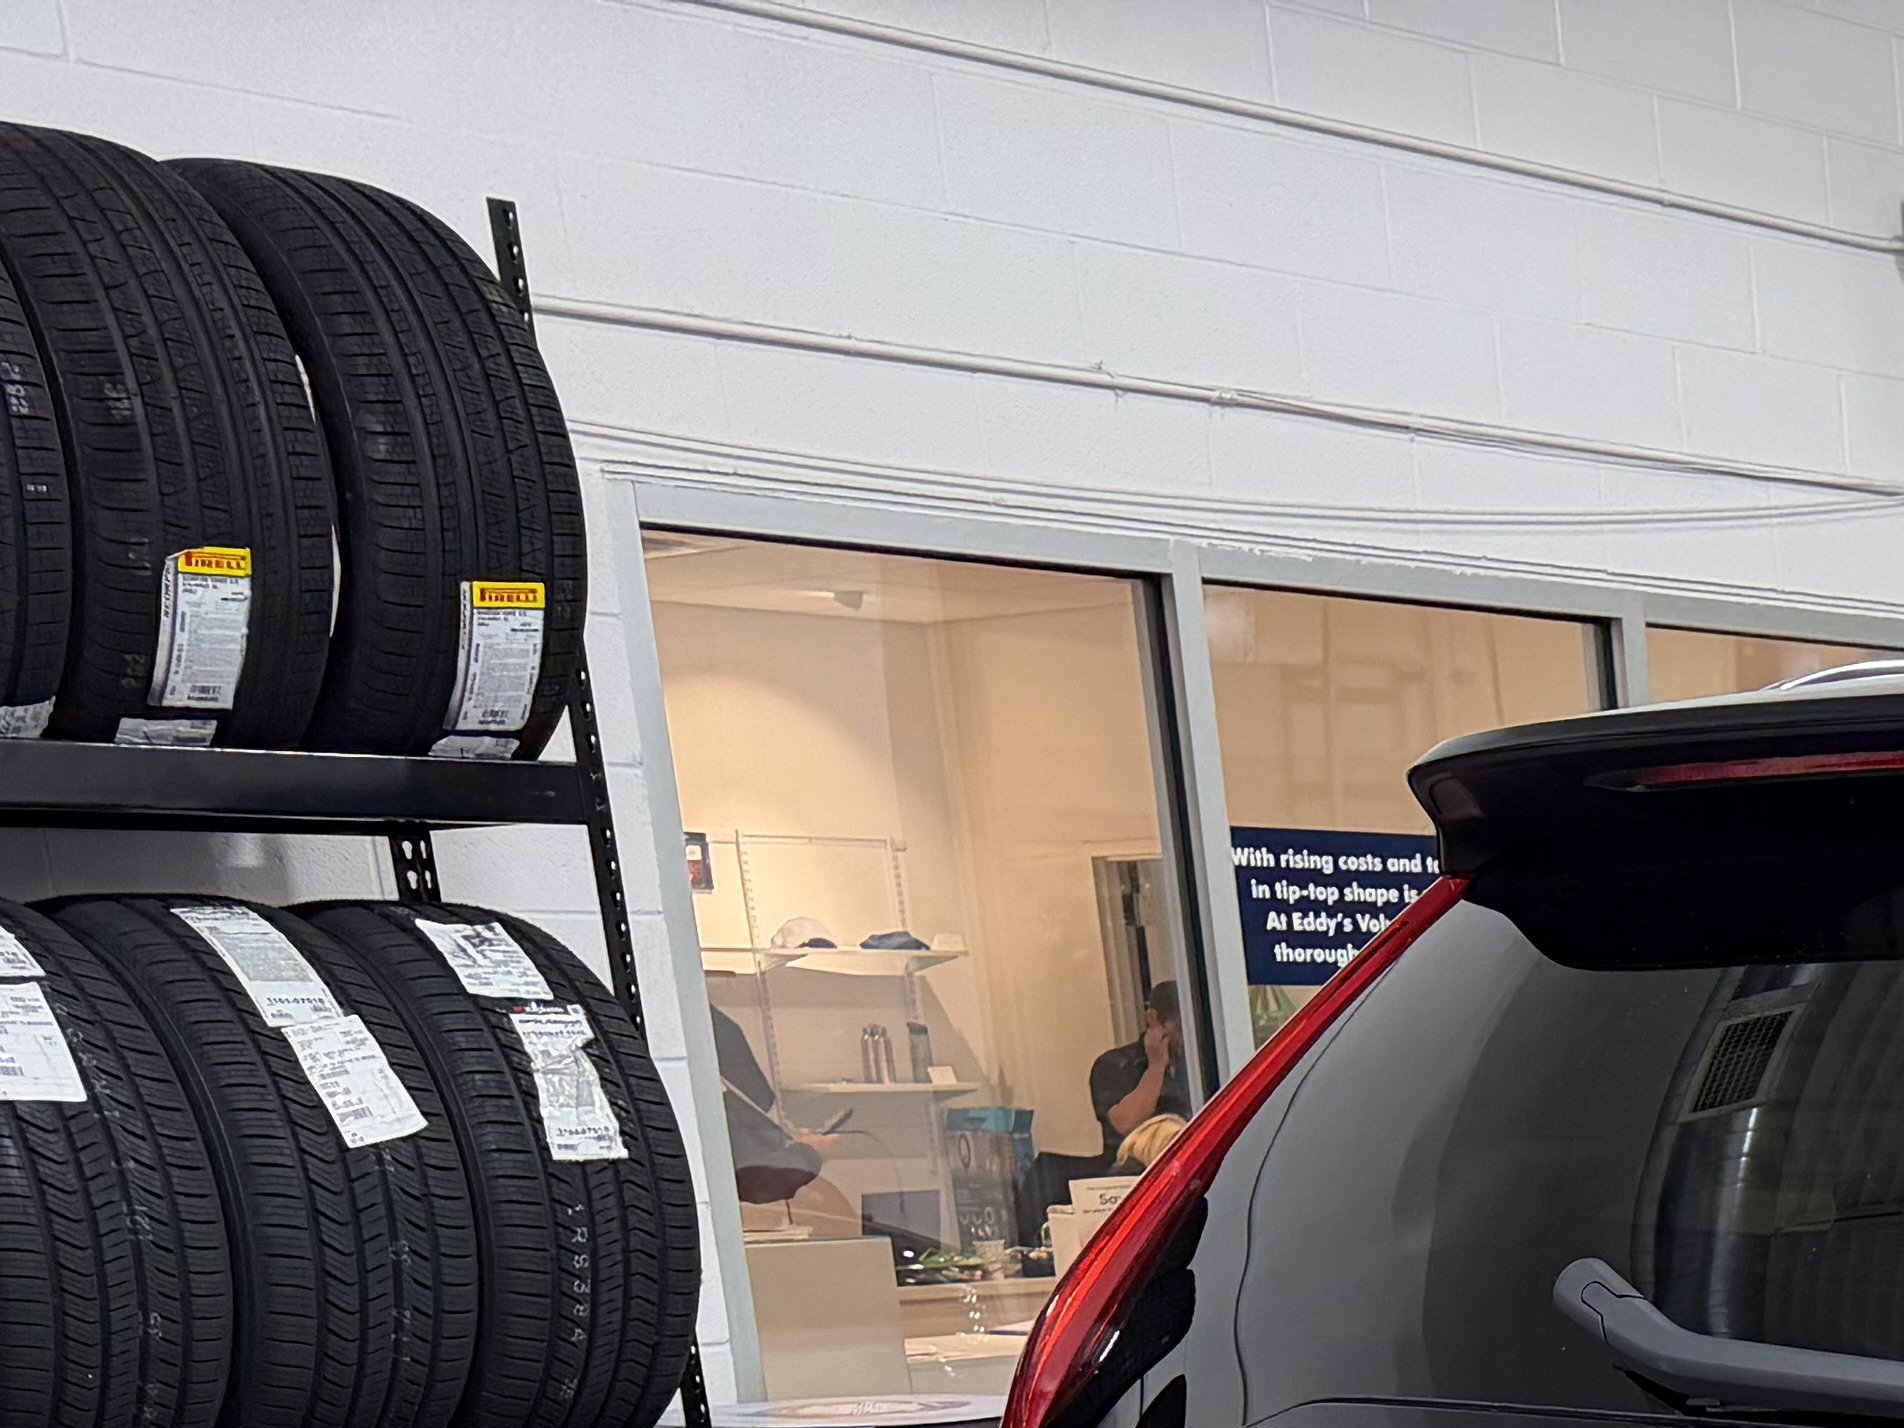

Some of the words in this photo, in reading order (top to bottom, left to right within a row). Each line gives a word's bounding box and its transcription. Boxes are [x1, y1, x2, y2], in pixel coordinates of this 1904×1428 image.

[184, 551, 247, 570] PIRELL
[479, 587, 538, 603] PIRELLI
[1230, 847, 1275, 868] With
[1280, 848, 1334, 875] rising
[1338, 853, 1383, 872] costs
[1387, 852, 1423, 873] and
[1250, 878, 1271, 900] in
[1274, 879, 1340, 906] tip-top
[1343, 881, 1399, 907] shape
[1266, 911, 1288, 931] At
[1291, 911, 1353, 937] Eddy's
